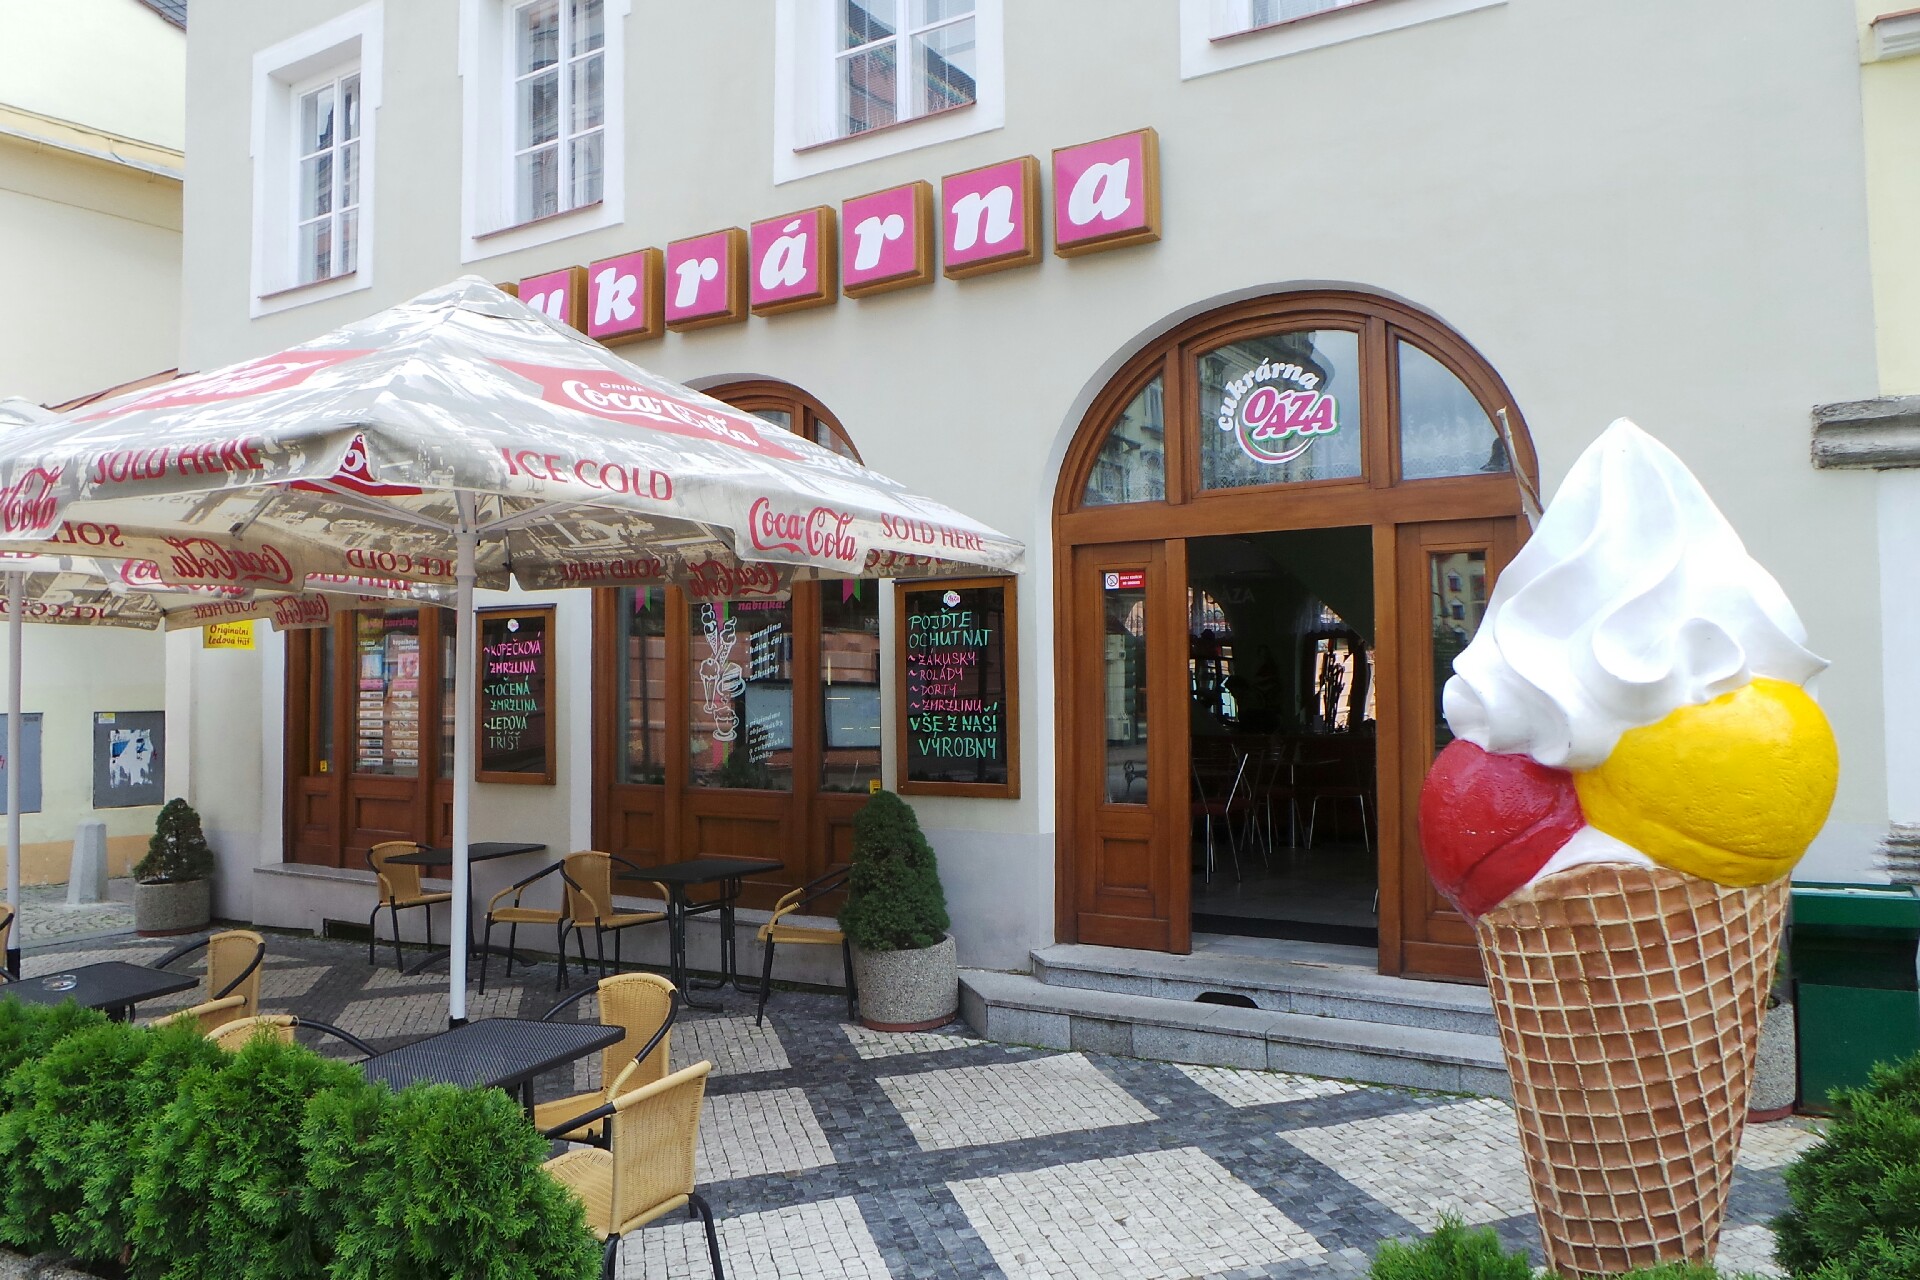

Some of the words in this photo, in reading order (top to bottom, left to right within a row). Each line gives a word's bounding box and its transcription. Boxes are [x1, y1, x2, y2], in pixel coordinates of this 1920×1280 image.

[527, 157, 1131, 326] ukrárna
[1218, 358, 1320, 432] cukrárna
[562, 380, 759, 447] Coca-Cola
[1243, 386, 1338, 441] OÁZA
[94, 446, 170, 485] SOLD
[177, 437, 265, 476] HERE
[502, 448, 568, 484] ICE
[575, 459, 673, 501] COLD
[748, 496, 858, 562] Coca-Cola
[881, 512, 935, 545] SOLD
[939, 524, 987, 553] HERE
[908, 607, 973, 631] POJĎTE
[490, 631, 542, 656] KOPEČKOVÁ
[489, 661, 536, 674] ZMRZLINA
[919, 664, 963, 681] ROLÁDY
[489, 675, 530, 696] TOČENÁ
[921, 683, 958, 698] DORTY
[490, 698, 537, 711] ZMRZLINA
[909, 712, 944, 733] VŠE
[947, 716, 958, 732] Z
[962, 702, 998, 733] NAŠÍ
[922, 699, 982, 713] ZMRZLINU
[490, 713, 529, 730] LEDOVÁ
[918, 732, 997, 760] VÝROBNY
